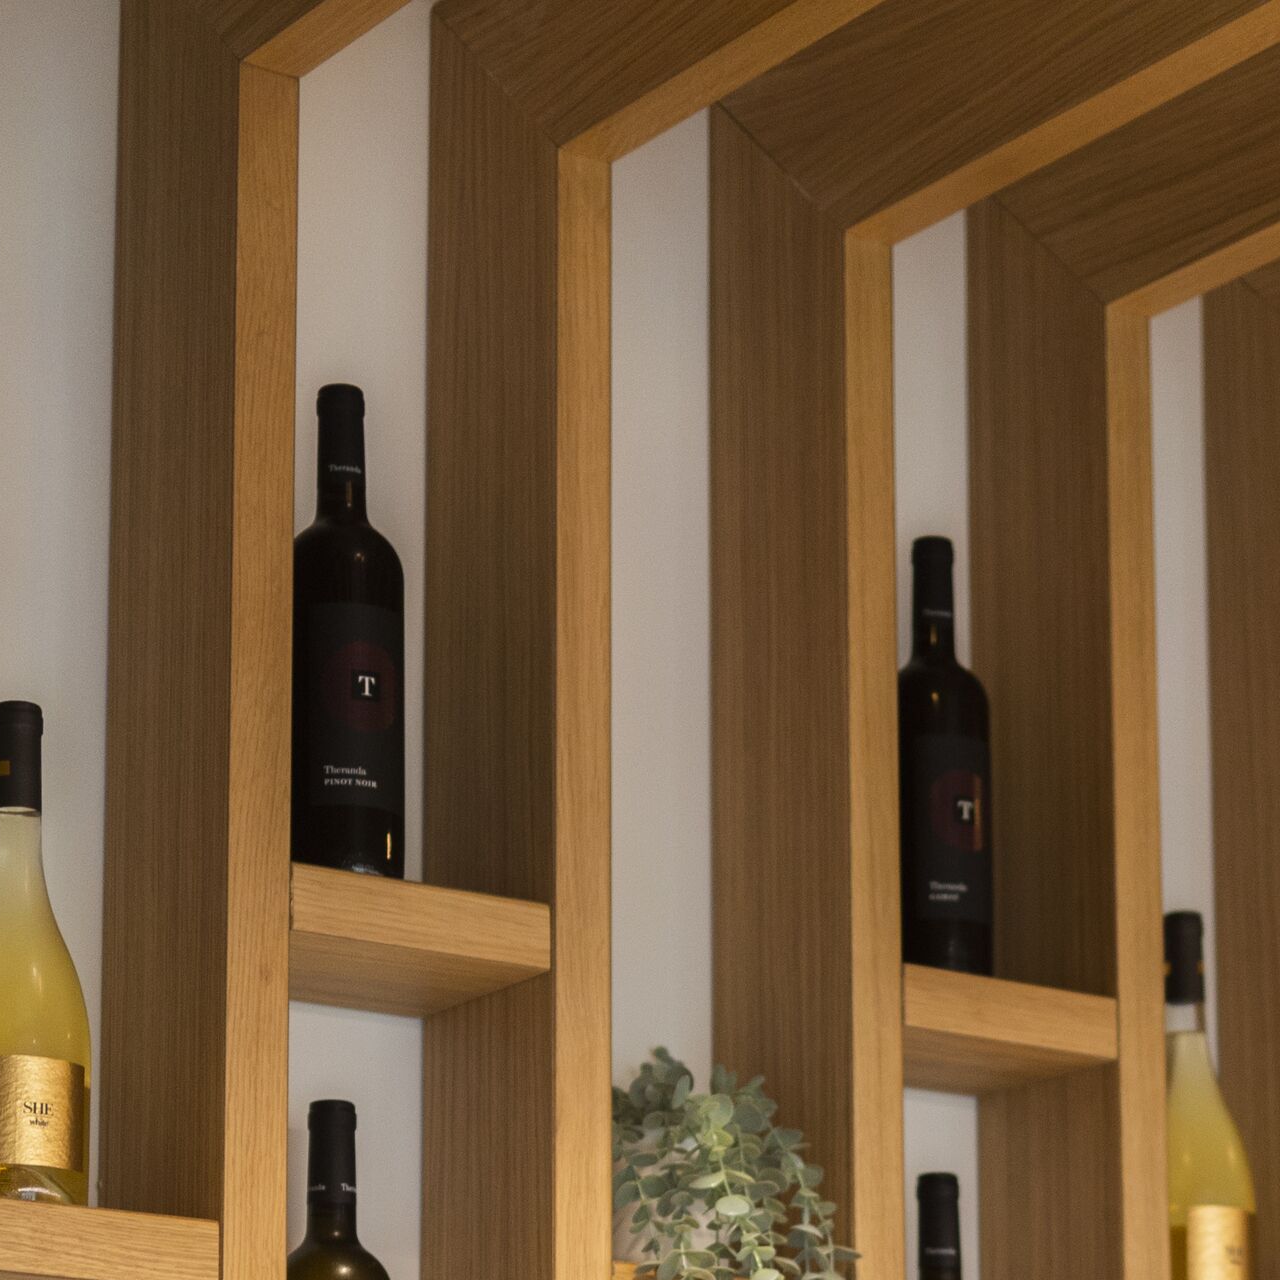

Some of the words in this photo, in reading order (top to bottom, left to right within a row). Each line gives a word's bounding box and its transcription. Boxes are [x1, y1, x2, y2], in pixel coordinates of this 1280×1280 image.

[358, 675, 376, 697] T
[323, 764, 367, 777] Theranda
[324, 777, 352, 787] PINOT
[354, 778, 377, 788] NOIR
[957, 799, 974, 821] T
[22, 1101, 54, 1118] SHE
